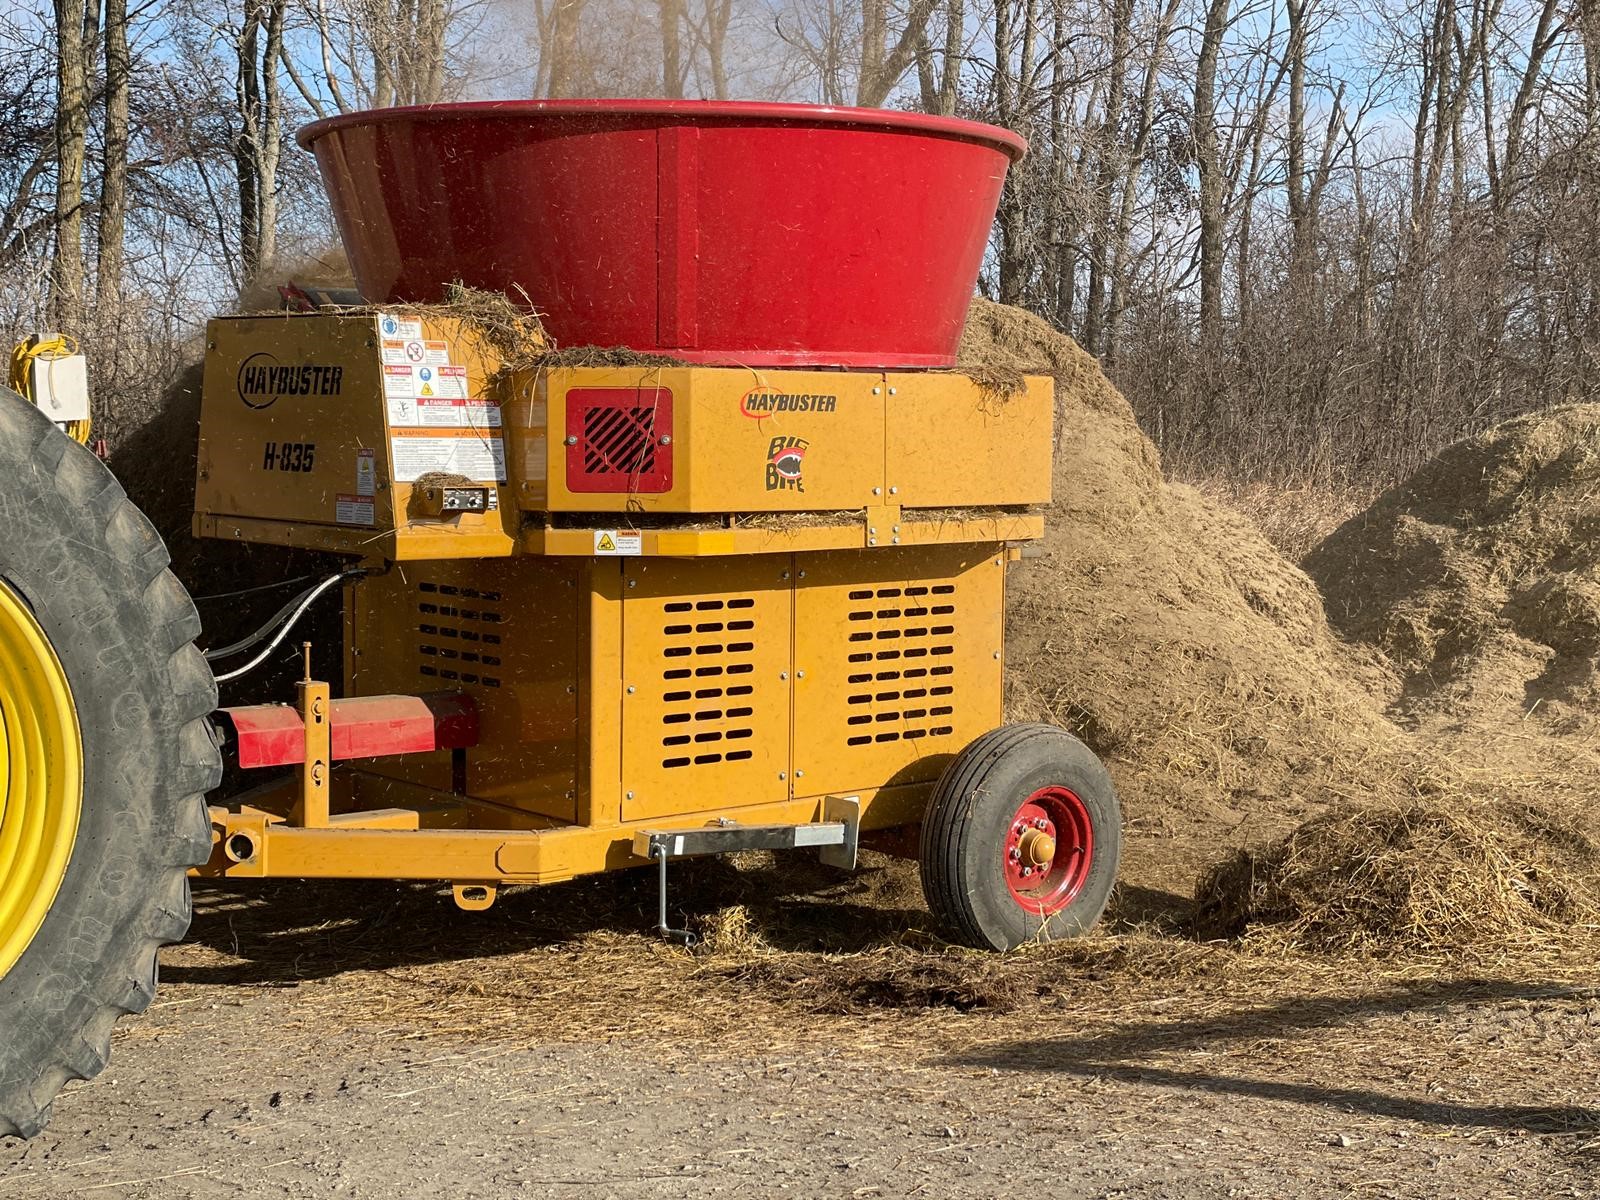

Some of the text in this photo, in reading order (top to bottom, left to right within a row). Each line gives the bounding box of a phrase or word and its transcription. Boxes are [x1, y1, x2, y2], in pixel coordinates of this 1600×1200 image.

[243, 366, 343, 395] HAYBUSTER
[745, 393, 837, 412] HAYBUSTER
[263, 442, 316, 473] H-835
[767, 436, 810, 460] BIG
[766, 462, 804, 493] BITE
